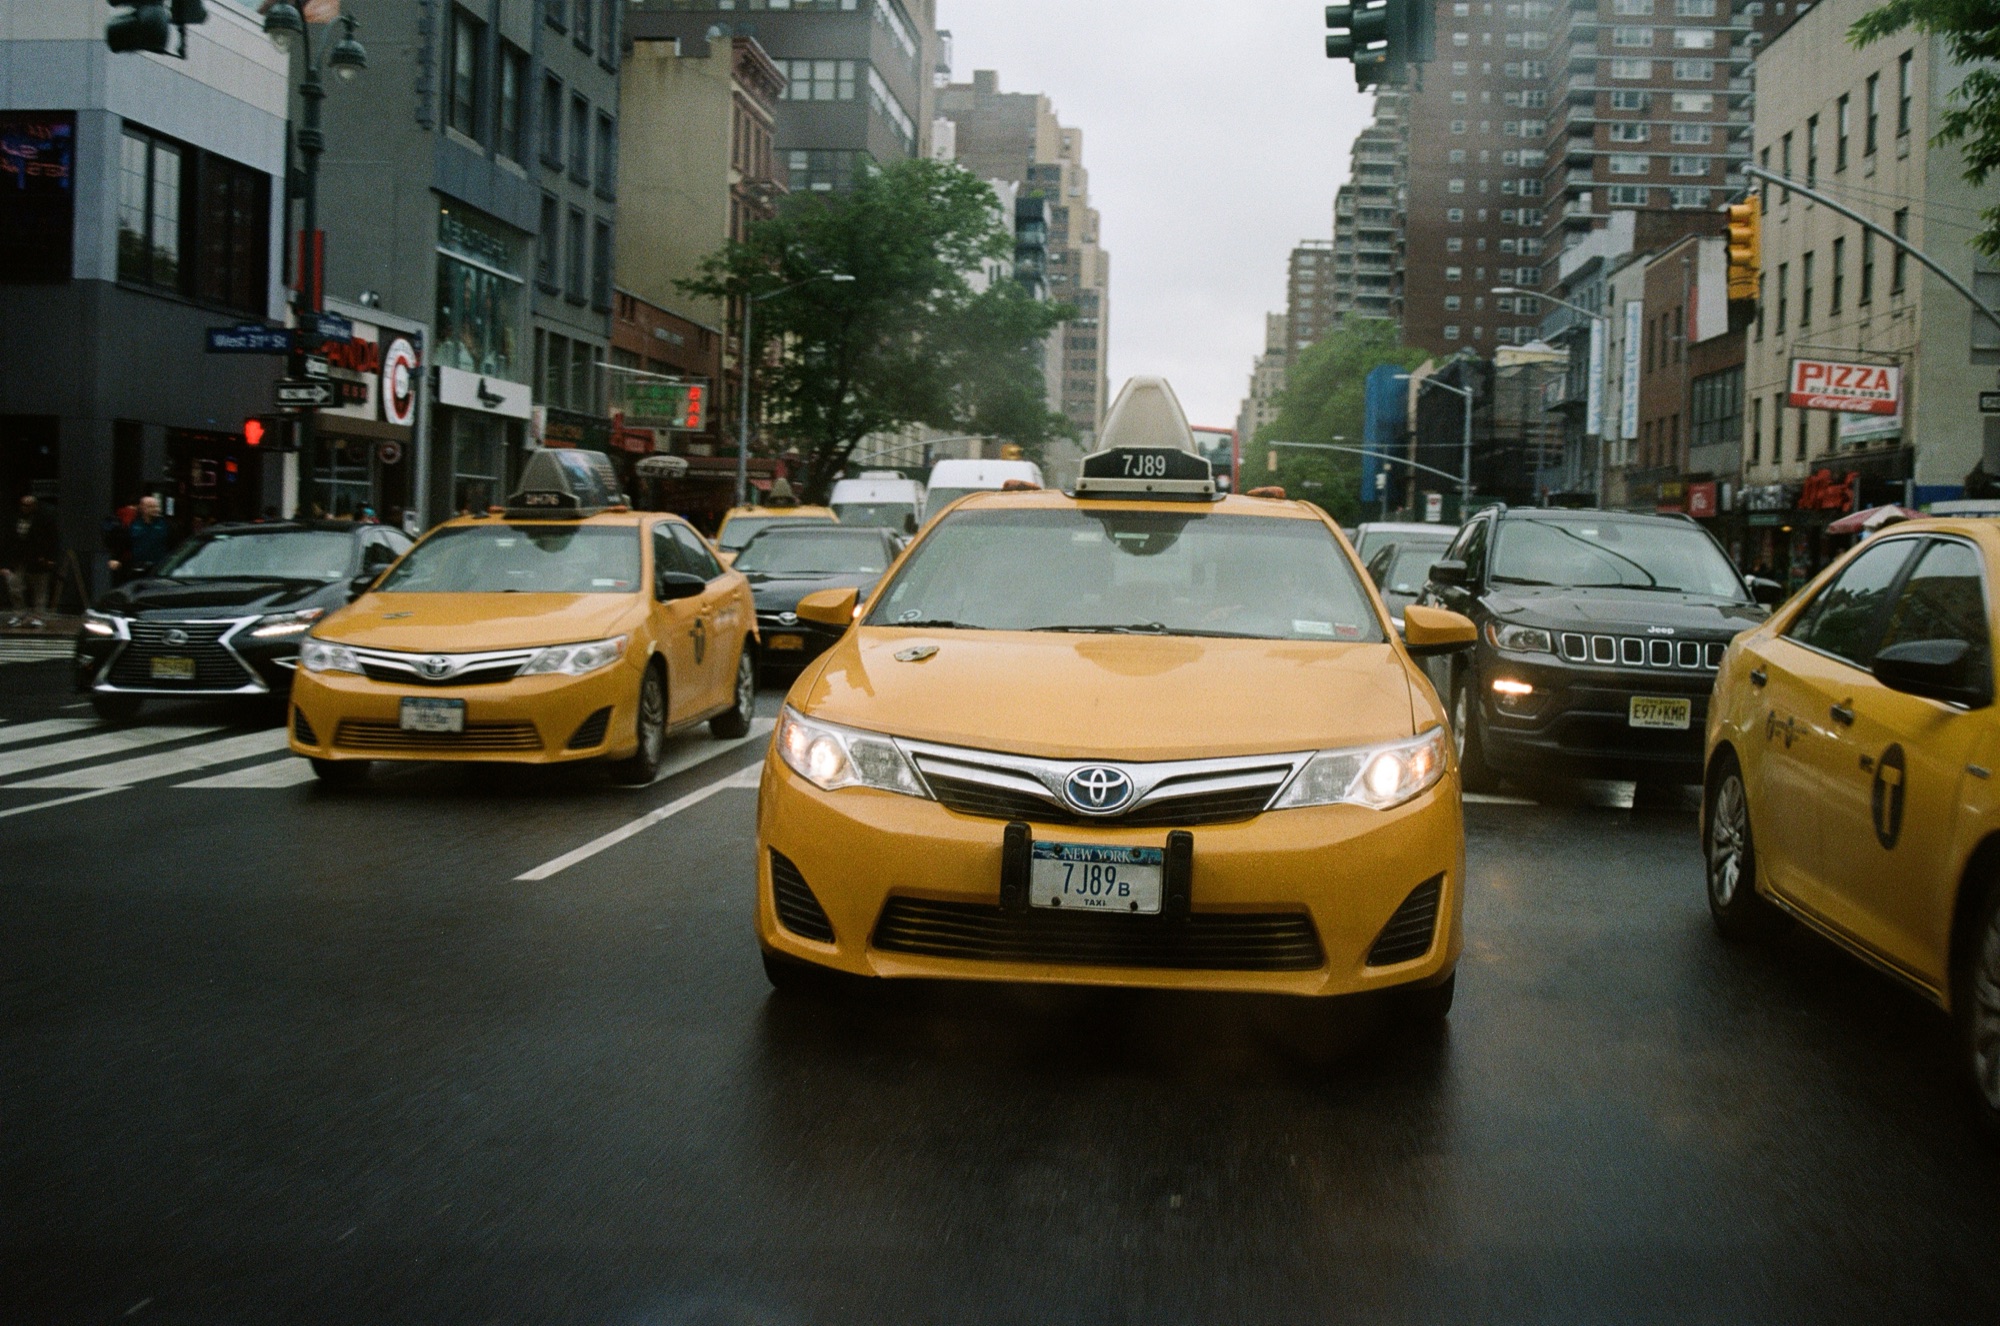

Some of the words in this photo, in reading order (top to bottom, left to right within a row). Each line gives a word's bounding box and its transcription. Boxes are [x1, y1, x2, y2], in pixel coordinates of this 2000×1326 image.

[1797, 363, 1890, 392] PIZZA
[1122, 454, 1166, 476] 7J89
[1647, 625, 1675, 635] Jeep
[1063, 847, 1092, 861] NEW
[1097, 849, 1131, 863] YORK
[1084, 898, 1106, 907] TAXI
